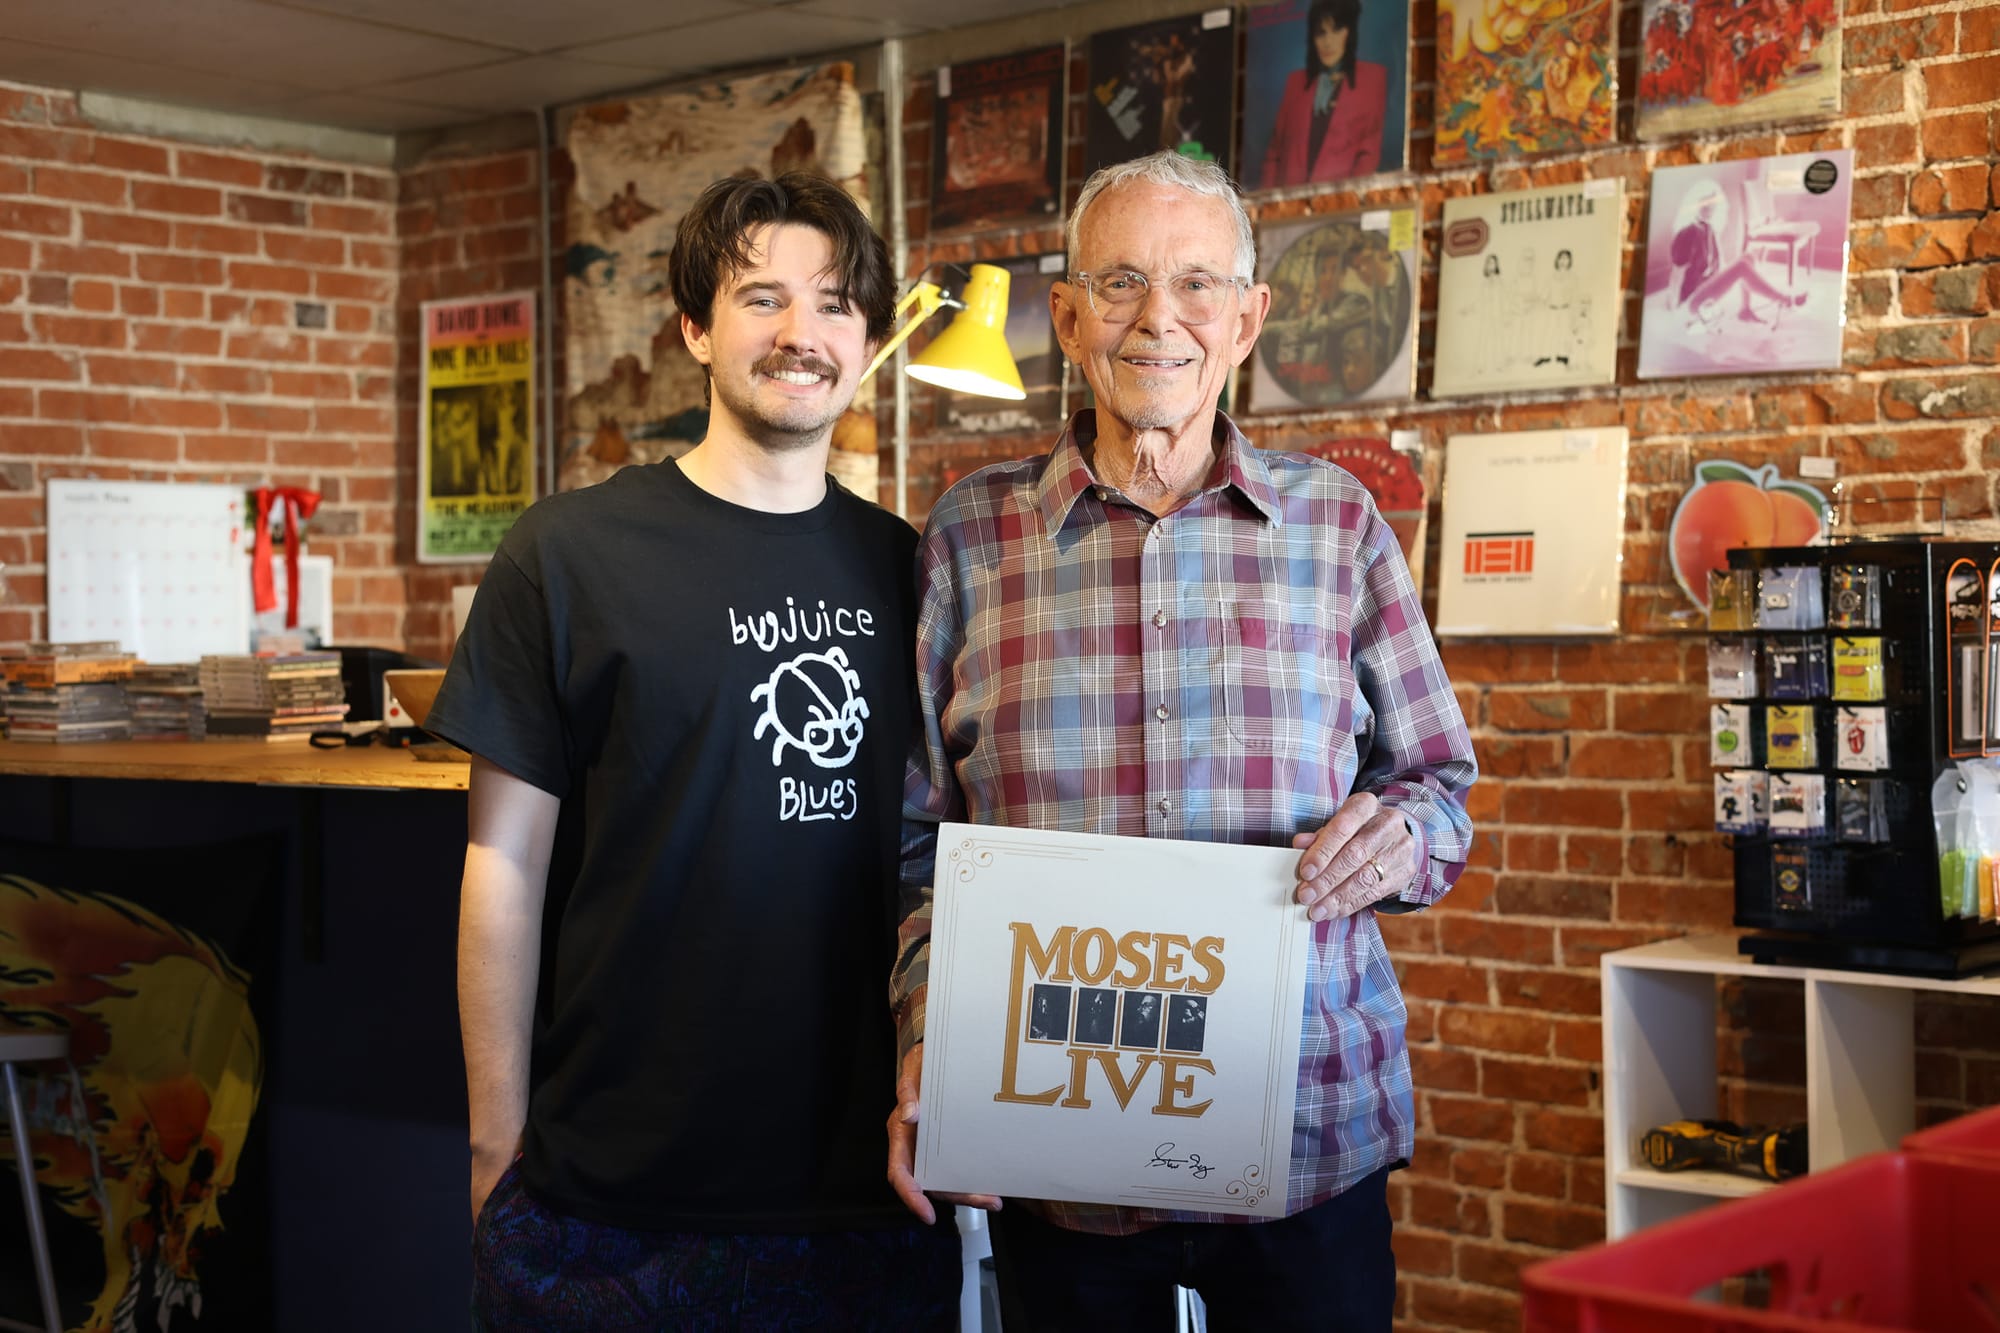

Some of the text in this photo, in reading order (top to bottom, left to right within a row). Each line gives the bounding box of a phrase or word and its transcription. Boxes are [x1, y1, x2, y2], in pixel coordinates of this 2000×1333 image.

[1501, 193, 1594, 224] STILLWATER
[1008, 921, 1226, 995] MOSES
[993, 988, 1217, 1119] LIVE
